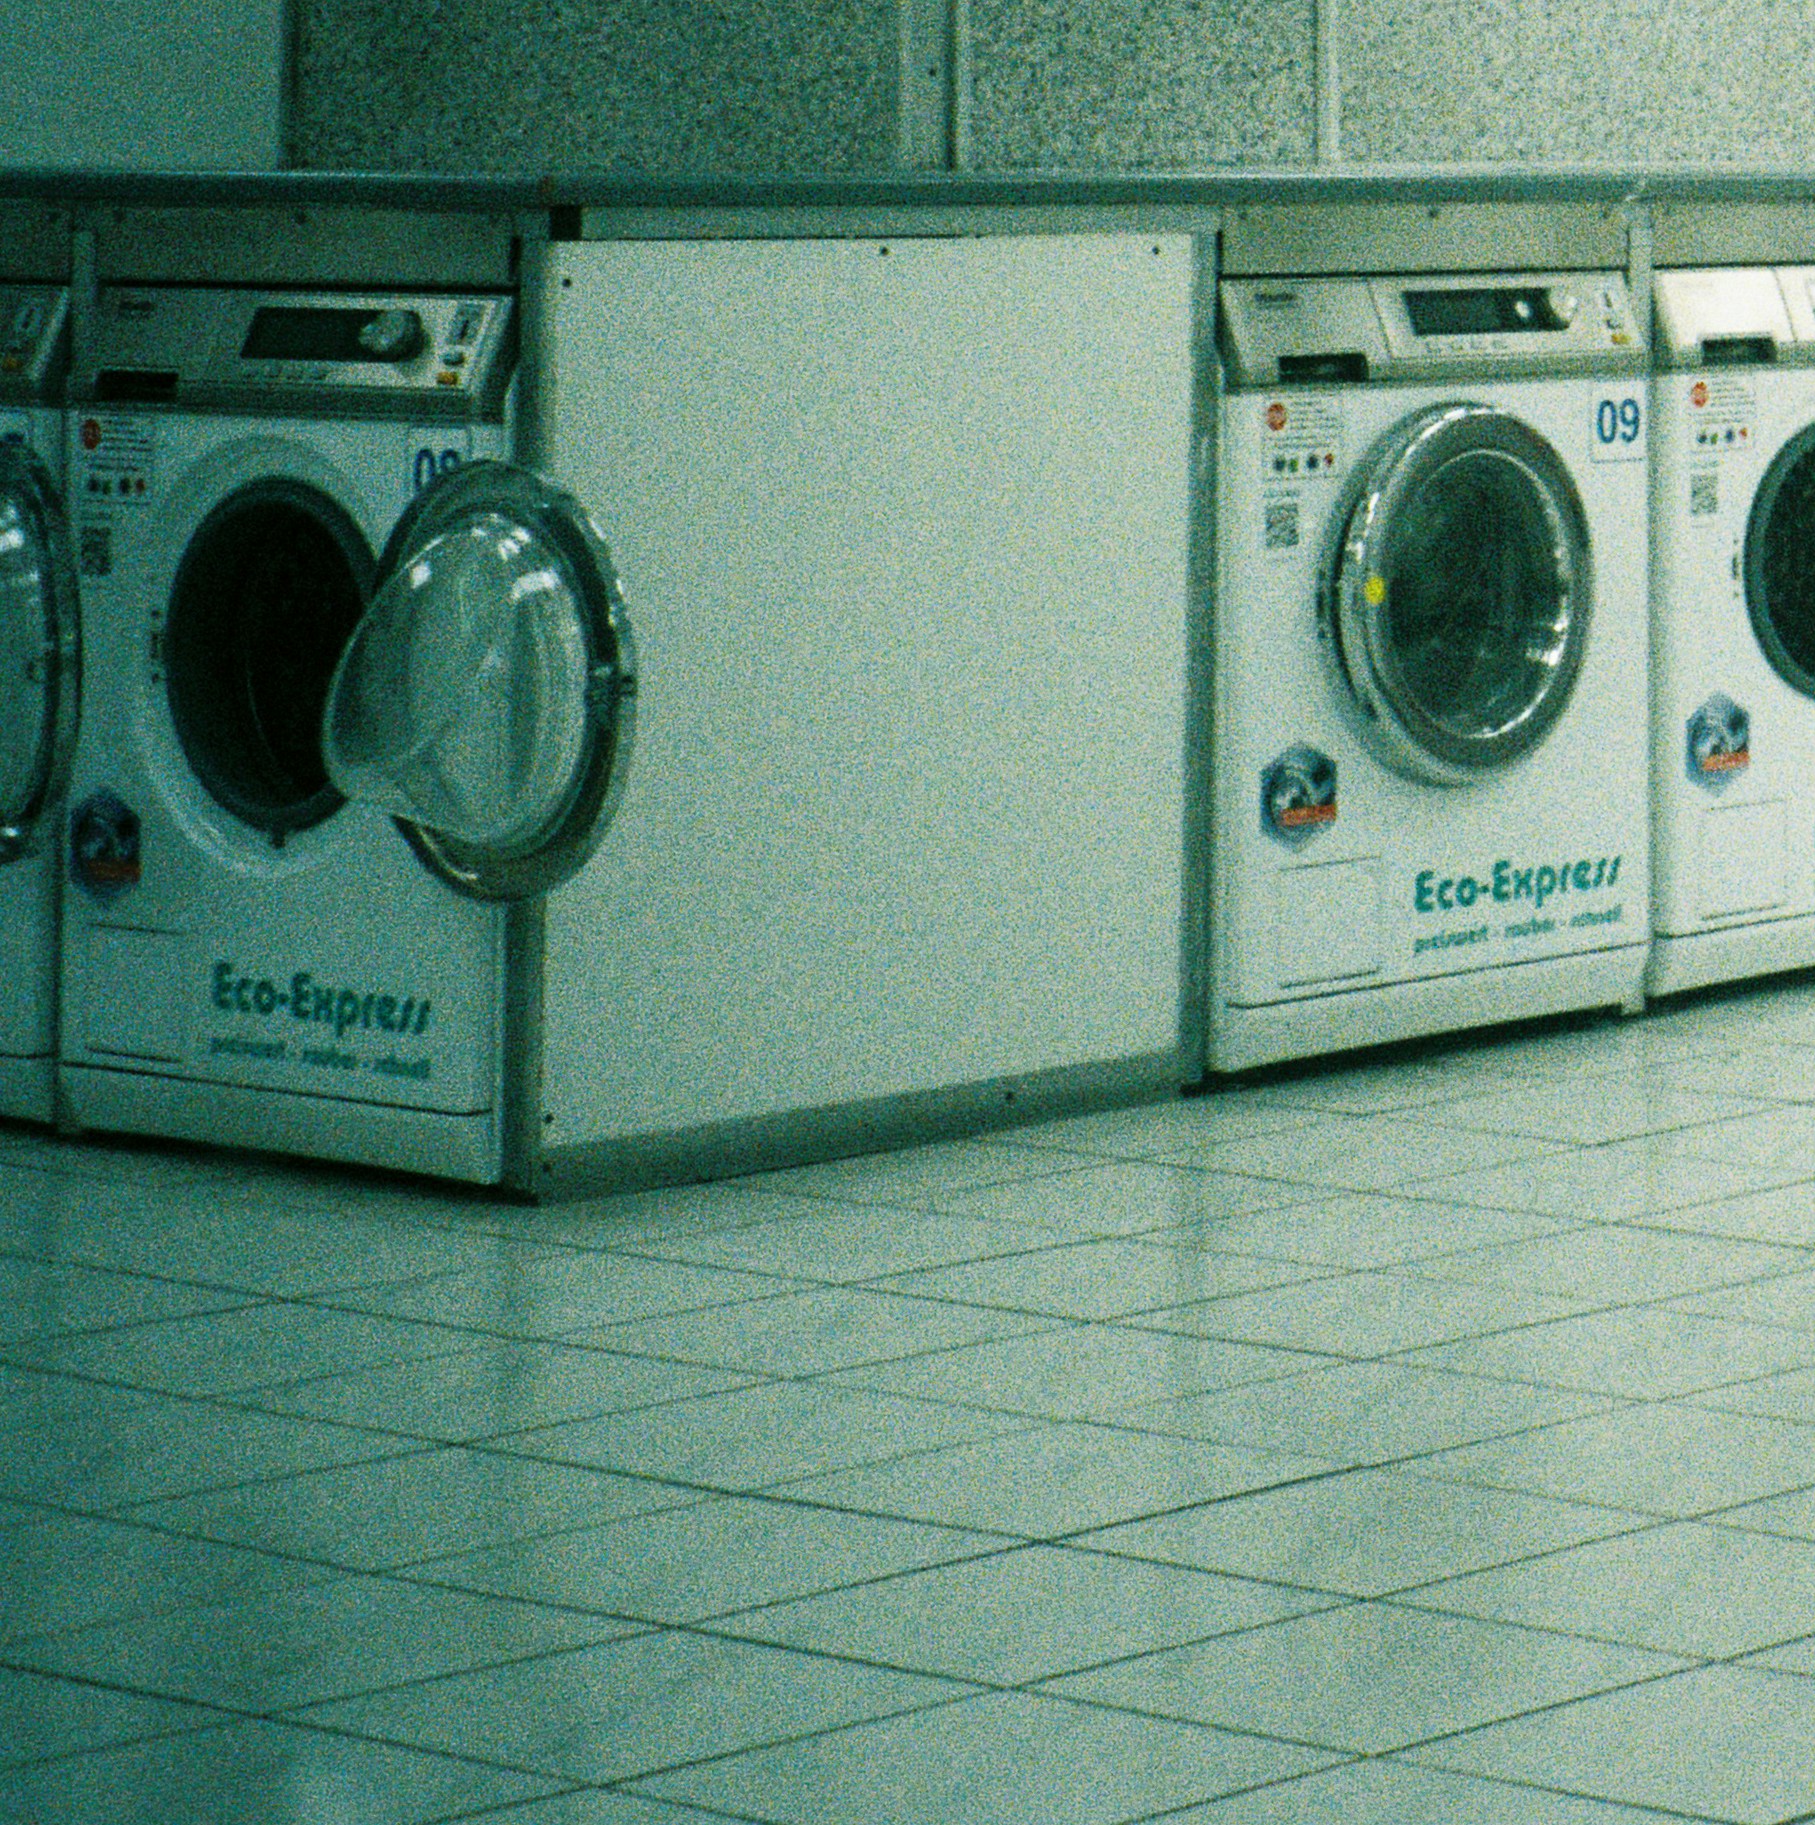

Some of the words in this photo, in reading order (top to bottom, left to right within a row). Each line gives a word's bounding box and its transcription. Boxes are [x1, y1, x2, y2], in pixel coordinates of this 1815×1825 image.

[1596, 397, 1641, 445] 09
[1414, 854, 1623, 913] Eco-Express
[212, 959, 431, 1038] Eco-Express
